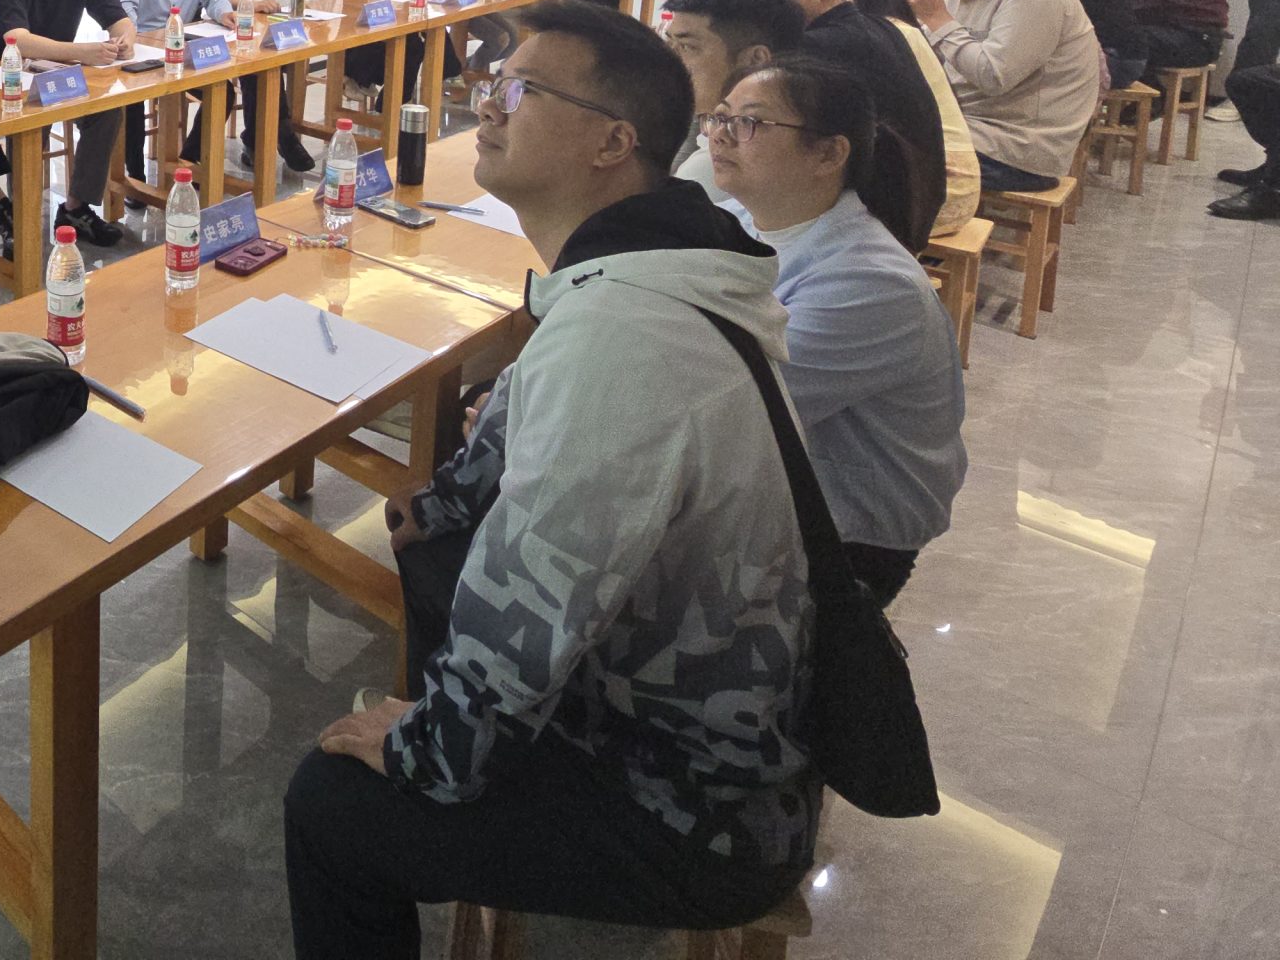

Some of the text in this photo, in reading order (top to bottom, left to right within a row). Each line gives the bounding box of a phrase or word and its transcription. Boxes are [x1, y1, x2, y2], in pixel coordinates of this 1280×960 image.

[355, 167, 378, 187] 才华
[204, 215, 245, 243] 史家亮
